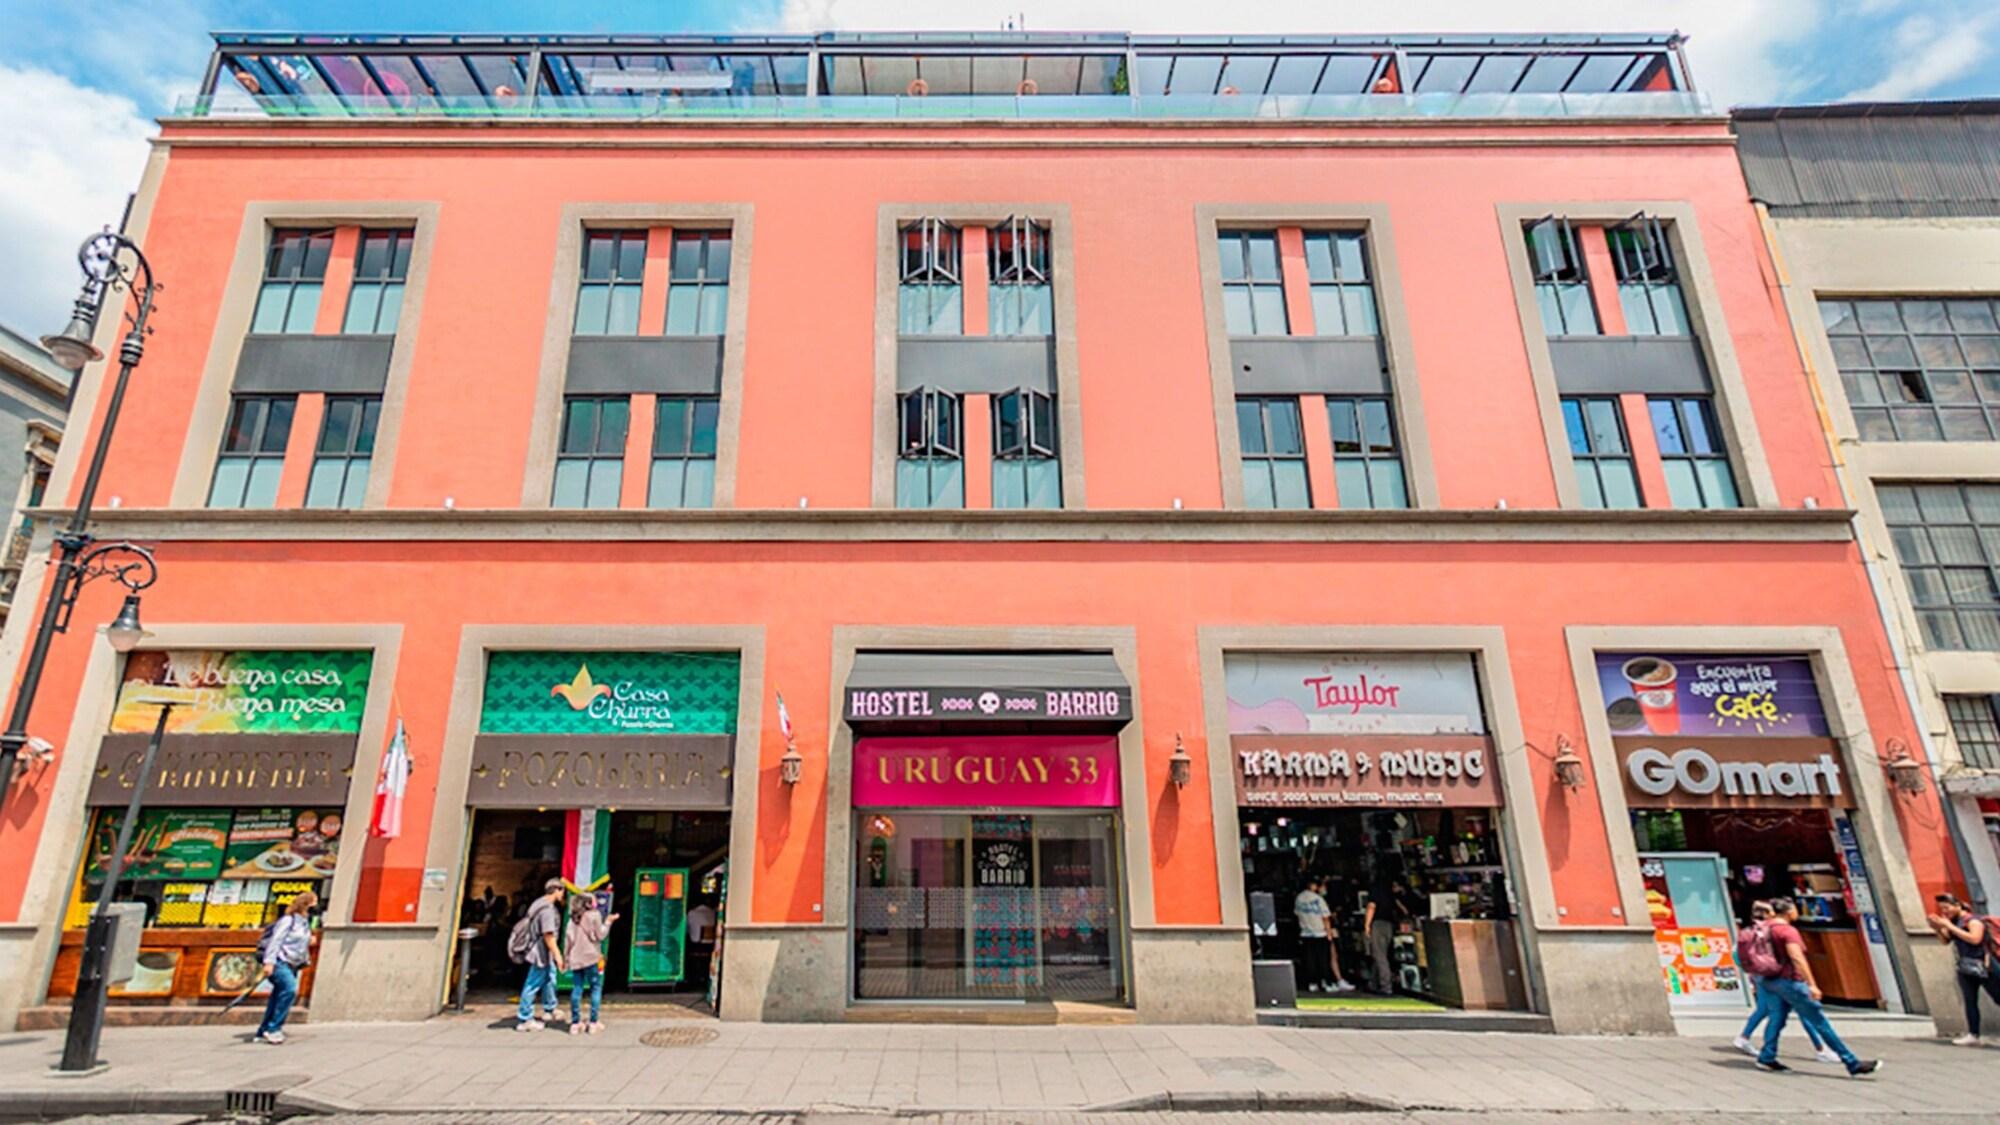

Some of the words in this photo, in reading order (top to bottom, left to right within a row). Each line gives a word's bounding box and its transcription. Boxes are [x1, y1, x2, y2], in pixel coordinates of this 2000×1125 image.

[203, 662, 277, 692] buena
[1697, 664, 1772, 681] Encuentra
[613, 680, 670, 702] Casa
[1303, 674, 1399, 715] Taylor
[1738, 680, 1778, 695] mejor
[279, 697, 346, 719] mesa
[588, 697, 672, 726] Churra
[852, 691, 933, 716] HOSTEL
[1045, 691, 1120, 716] BARRIO
[878, 756, 1053, 784] URUGUAY
[1064, 757, 1099, 785] 33
[1240, 749, 1352, 777] KARMA
[1380, 749, 1485, 779] MUSIC
[1626, 747, 1842, 796] GOmart
[981, 868, 1025, 885] BARRIO
